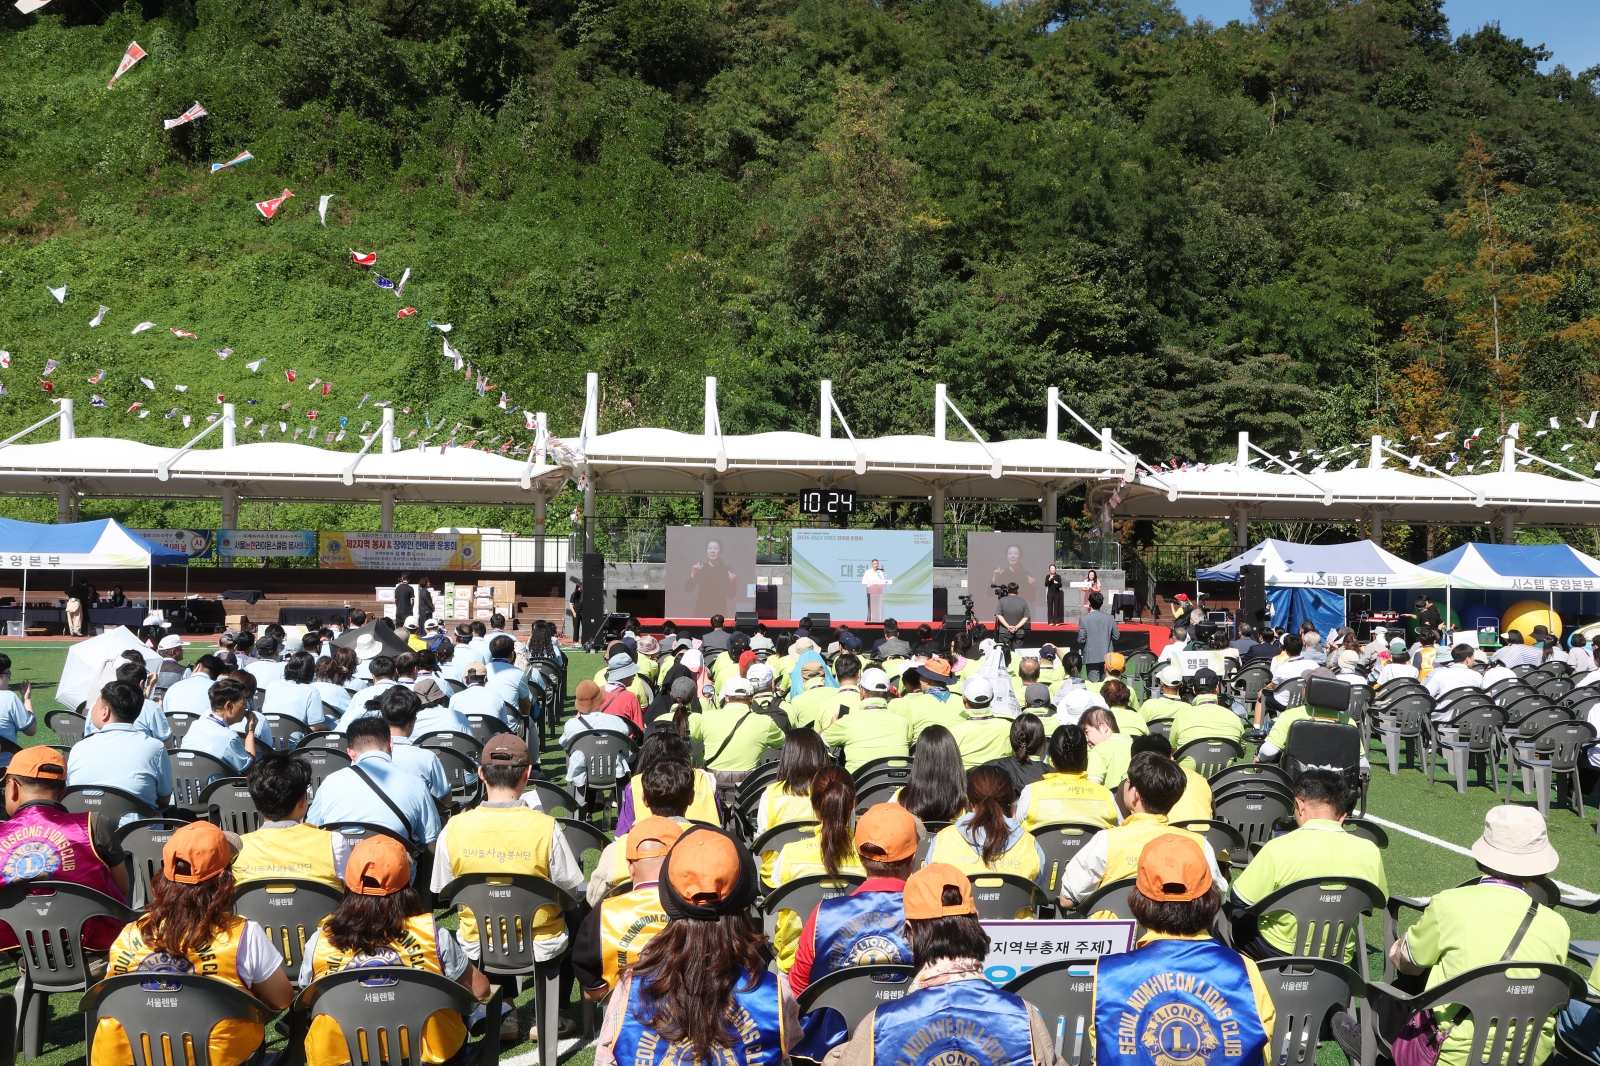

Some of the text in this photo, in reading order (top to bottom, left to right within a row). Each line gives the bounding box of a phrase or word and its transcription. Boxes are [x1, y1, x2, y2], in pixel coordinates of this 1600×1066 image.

[234, 540, 287, 550] 서울논현라이온스클럽
[346, 540, 370, 549] 제2지역
[372, 540, 386, 550] 봉사
[393, 540, 414, 550] 장애인
[416, 540, 436, 550] 한마음
[438, 540, 458, 551] 운동회
[1304, 575, 1387, 587] 시스템 운영본부
[1512, 578, 1594, 590] 시스템 운영본부
[463, 848, 531, 864] 인사돌사랑봉사단
[488, 890, 512, 898] 서울렌탈
[978, 892, 1000, 901] 서울렌탈
[1319, 894, 1342, 902] 서울렌탈
[268, 898, 294, 906] 서울렌탈
[858, 938, 895, 952] LIONS
[993, 940, 1070, 955] 지역부총재
[617, 950, 628, 968] EOUL
[1070, 982, 1092, 992] 서울렌
[1280, 980, 1308, 991] 서울렌탈
[1506, 984, 1534, 995] 서울렌탈
[364, 991, 395, 1002] 서울렌탈
[875, 990, 904, 1000] 서울렌탈
[146, 998, 178, 1008] 서울렌탈
[1118, 972, 1242, 1056] SEOUL NONHYEON LIONS CLUB
[1157, 1006, 1200, 1022] LIONS
[902, 1017, 976, 1060] NONHYEON
[1171, 1026, 1192, 1052] L
[634, 1030, 660, 1066] EOUL
